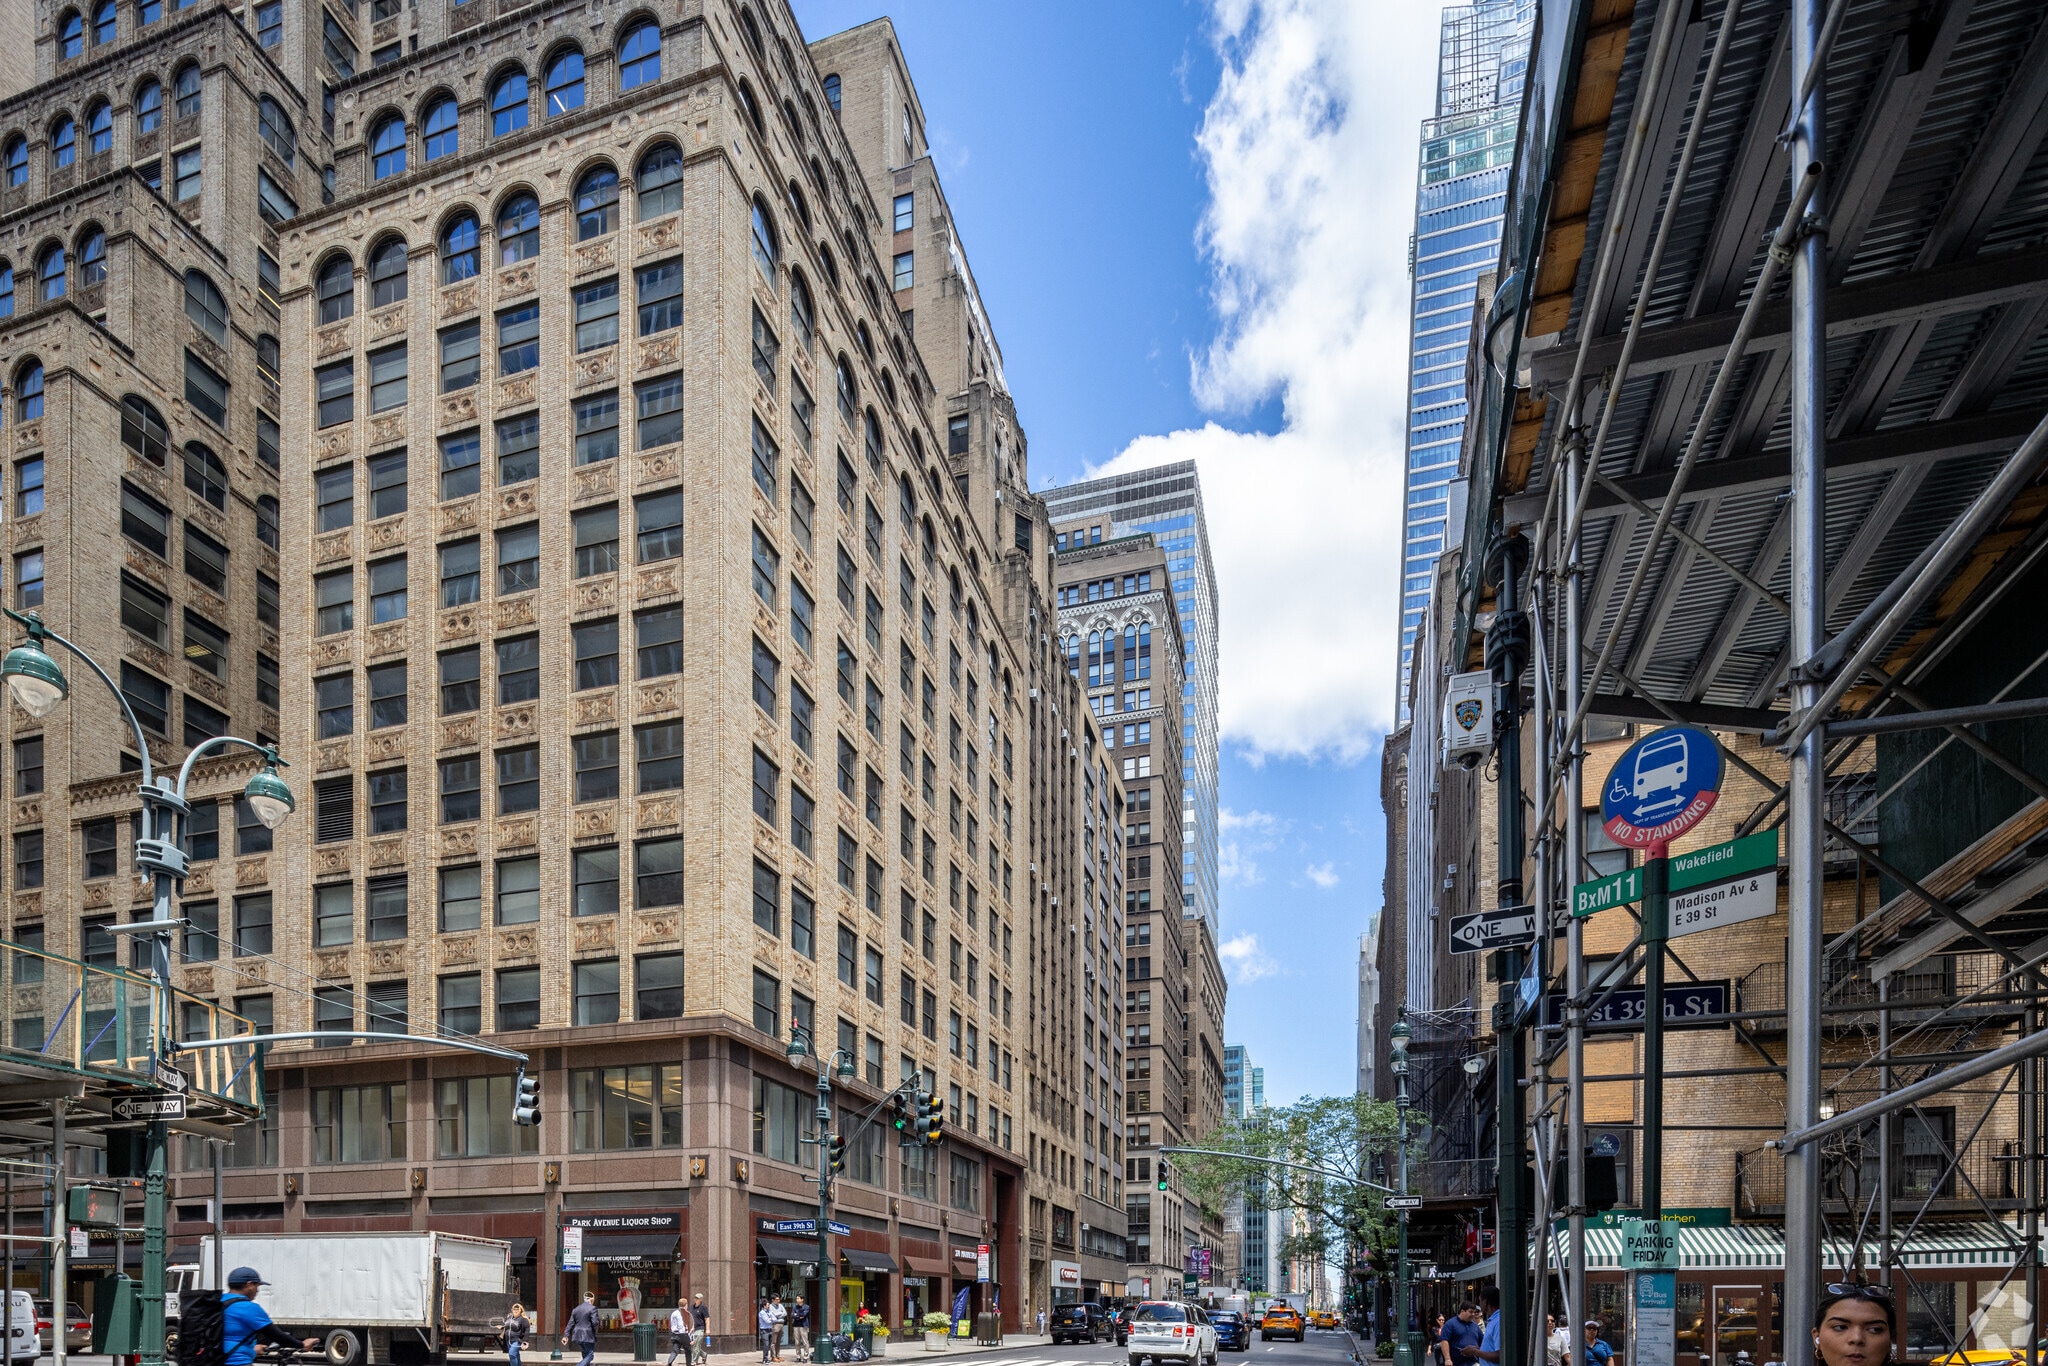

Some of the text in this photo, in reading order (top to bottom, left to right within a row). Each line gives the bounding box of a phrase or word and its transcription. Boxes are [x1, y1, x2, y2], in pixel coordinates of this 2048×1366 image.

[1650, 808, 1683, 820] TRANSPORTATION
[1612, 799, 1707, 842] NO STANDING
[1675, 846, 1734, 872] Wakefield
[1578, 873, 1636, 911] BxM11
[1675, 879, 1759, 911] Madison Av &
[1675, 906, 1717, 926] E 39 St
[1463, 912, 1563, 940] ONE WY
[1558, 995, 1713, 1023] st 39h St
[165, 1071, 178, 1085] WAY
[120, 1102, 178, 1114] ONE WAY
[572, 1216, 672, 1227] PARK AVENUE LIQUOR SHOP
[1617, 1214, 1696, 1223] Fres itchen
[762, 1220, 775, 1230] PARK
[806, 1221, 813, 1229] St
[828, 1223, 843, 1232] Madison
[1644, 1222, 1660, 1235] NO
[1632, 1250, 1667, 1262] FRIDAY
[1145, 1266, 1158, 1275] 286
[903, 1277, 927, 1286] ARKETPLACE
